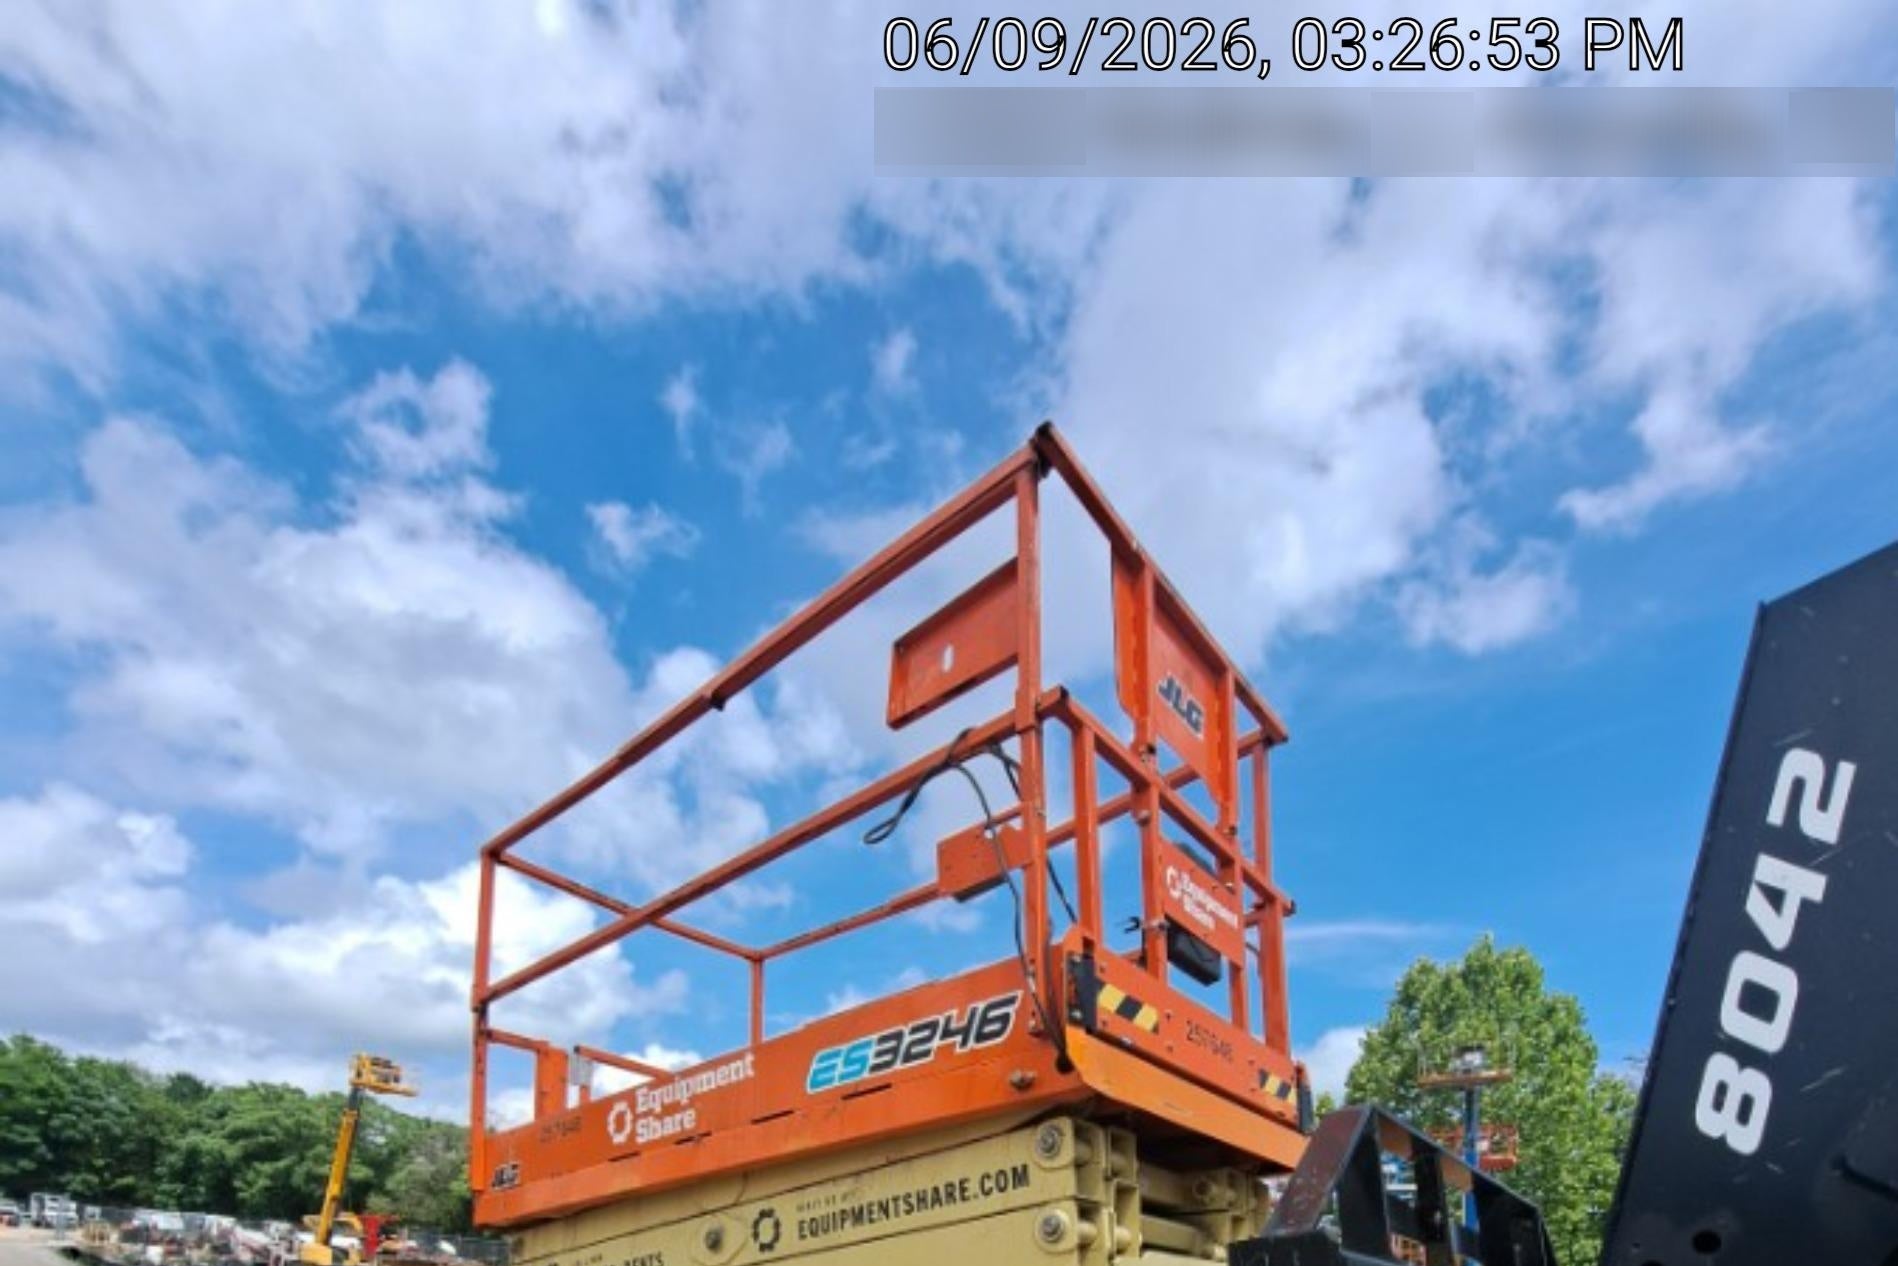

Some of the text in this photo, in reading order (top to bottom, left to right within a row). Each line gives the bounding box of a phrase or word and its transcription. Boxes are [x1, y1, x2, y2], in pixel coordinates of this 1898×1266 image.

[1156, 674, 1204, 735] JLG
[1695, 747, 1857, 1156] 8042
[806, 989, 1023, 1094] ES3246
[635, 1050, 755, 1115] Equipment
[635, 1107, 697, 1145] Share
[797, 1163, 1031, 1241] EQUIPMENTSHARE.COM
